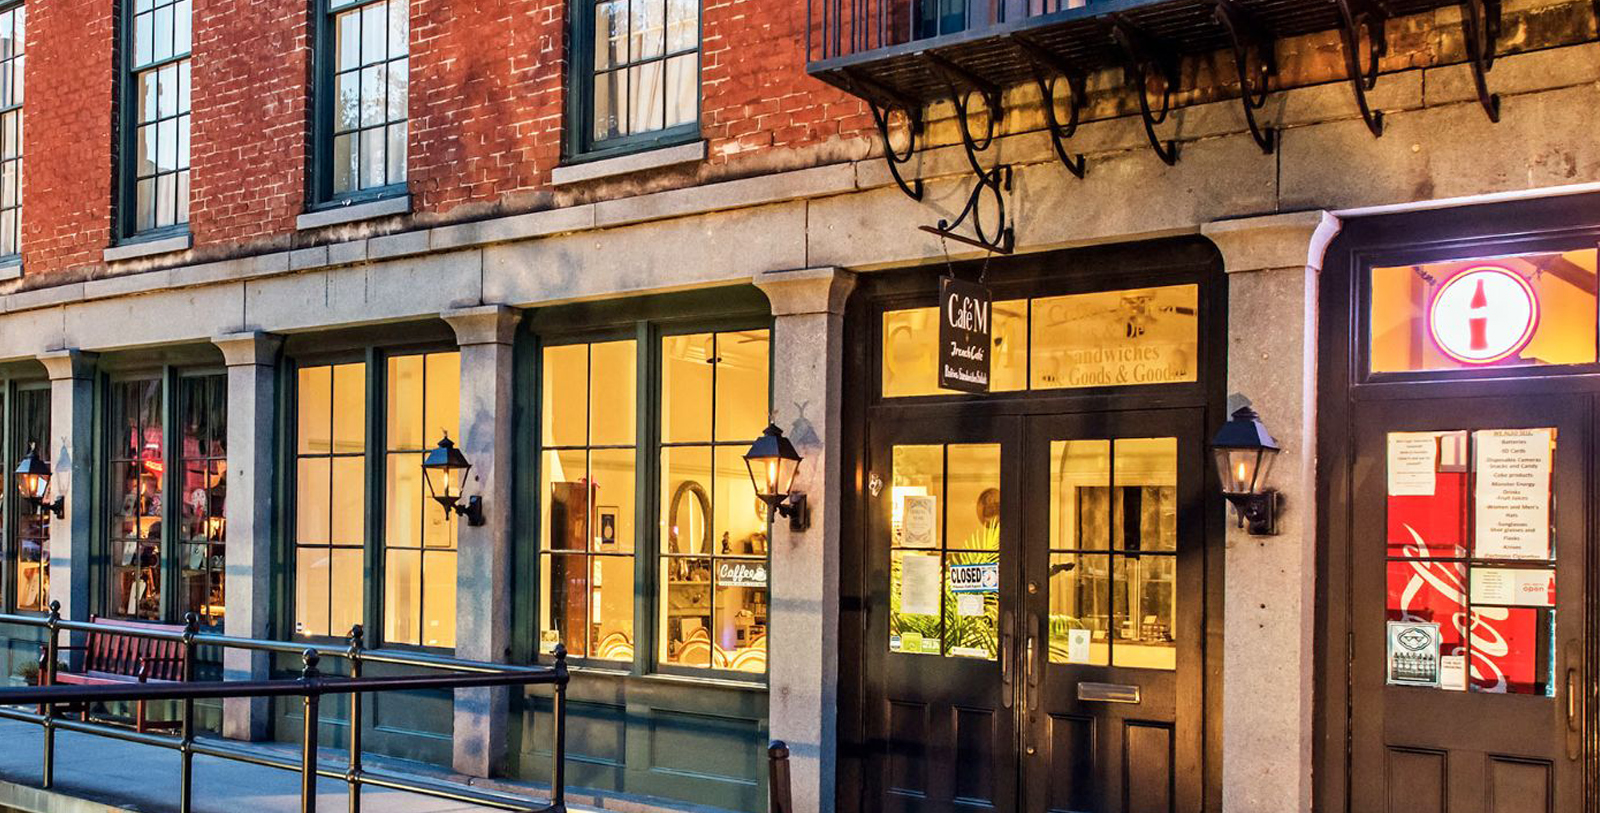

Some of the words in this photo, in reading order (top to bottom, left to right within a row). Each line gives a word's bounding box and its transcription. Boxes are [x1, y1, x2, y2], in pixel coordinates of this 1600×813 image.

[948, 293, 973, 331] Café
[973, 298, 988, 334] M
[1063, 345, 1160, 365] Sandwiches
[1069, 365, 1112, 386] Goods
[1115, 364, 1128, 384] &
[720, 563, 755, 582] Coffee
[951, 567, 982, 584] CLOSED
